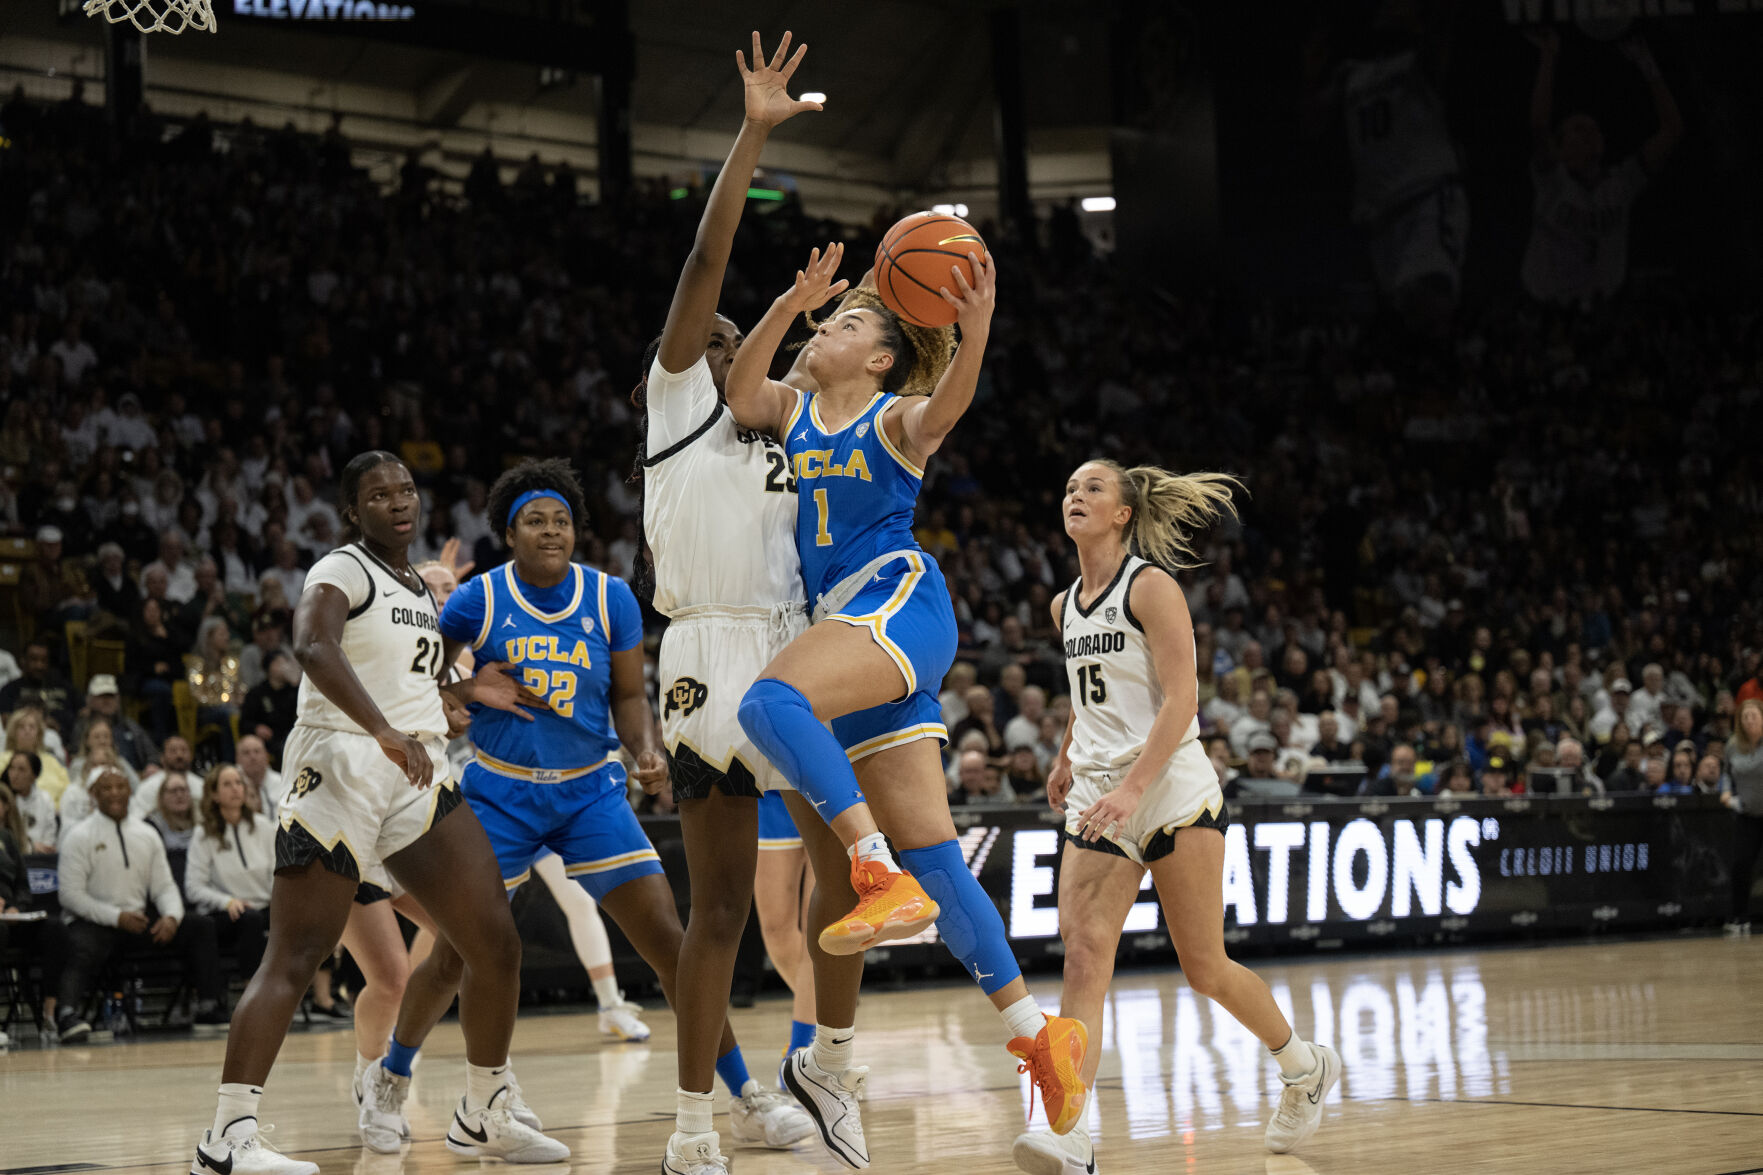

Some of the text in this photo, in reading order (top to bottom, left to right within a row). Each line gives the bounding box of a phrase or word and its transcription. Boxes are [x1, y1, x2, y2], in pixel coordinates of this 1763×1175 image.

[813, 488, 833, 546] 1
[391, 606, 441, 634] COLORA
[409, 636, 440, 677] 21
[505, 635, 591, 670] UCLA
[523, 667, 577, 718] 22
[1076, 663, 1107, 707] 15
